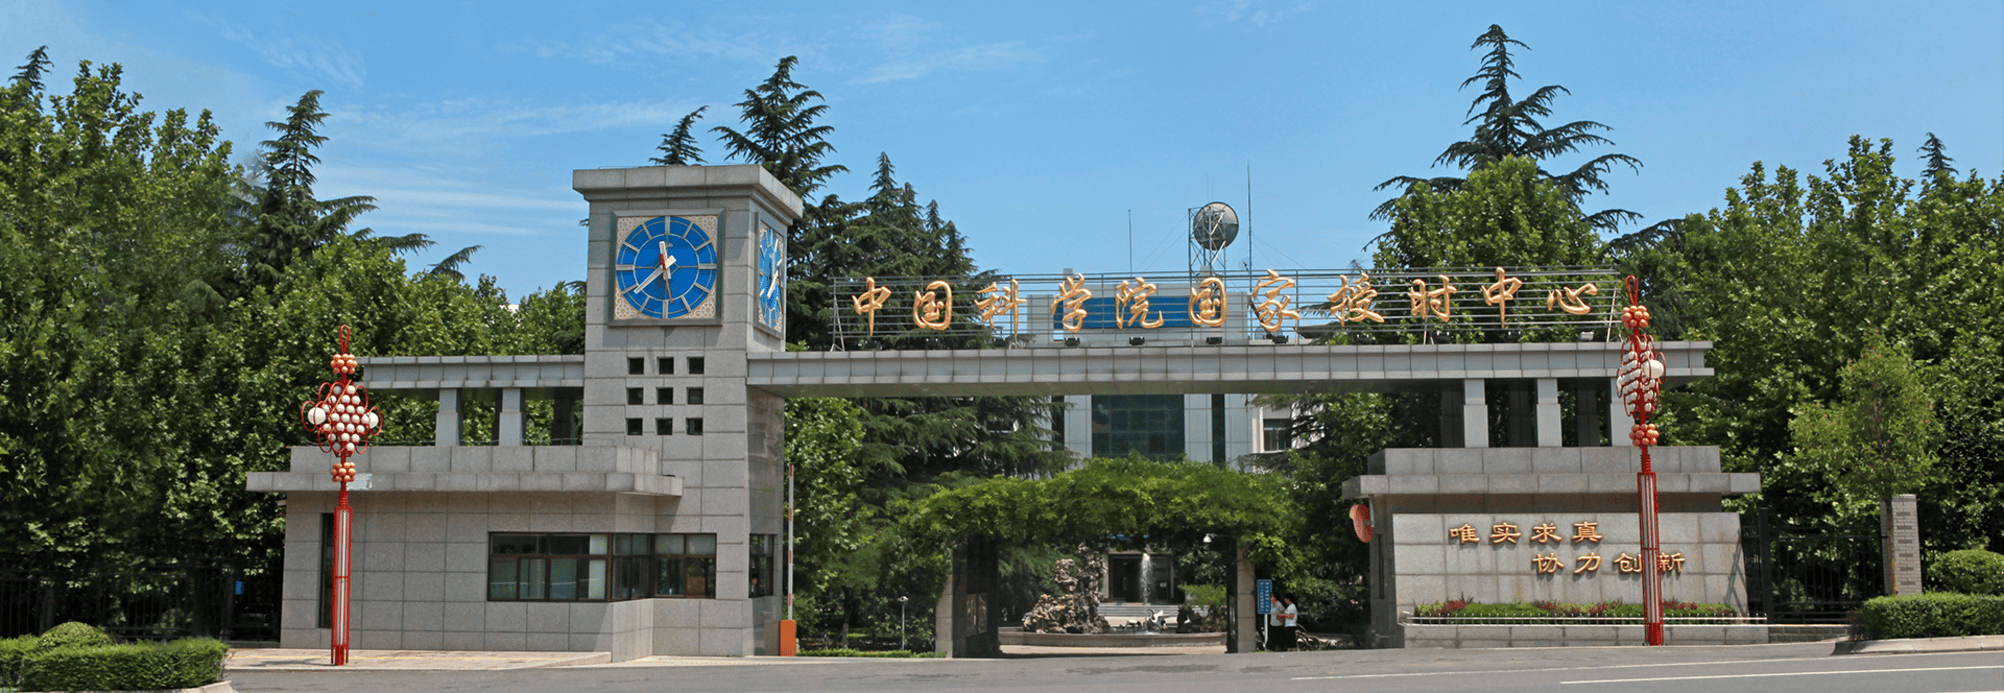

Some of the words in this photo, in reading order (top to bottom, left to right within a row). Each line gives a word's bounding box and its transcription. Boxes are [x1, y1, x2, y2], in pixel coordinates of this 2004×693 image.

[851, 266, 1598, 336] 中国科学院国家授时中心
[1450, 522, 1602, 543] 唯实求真
[1532, 552, 1686, 573] 协力创新
